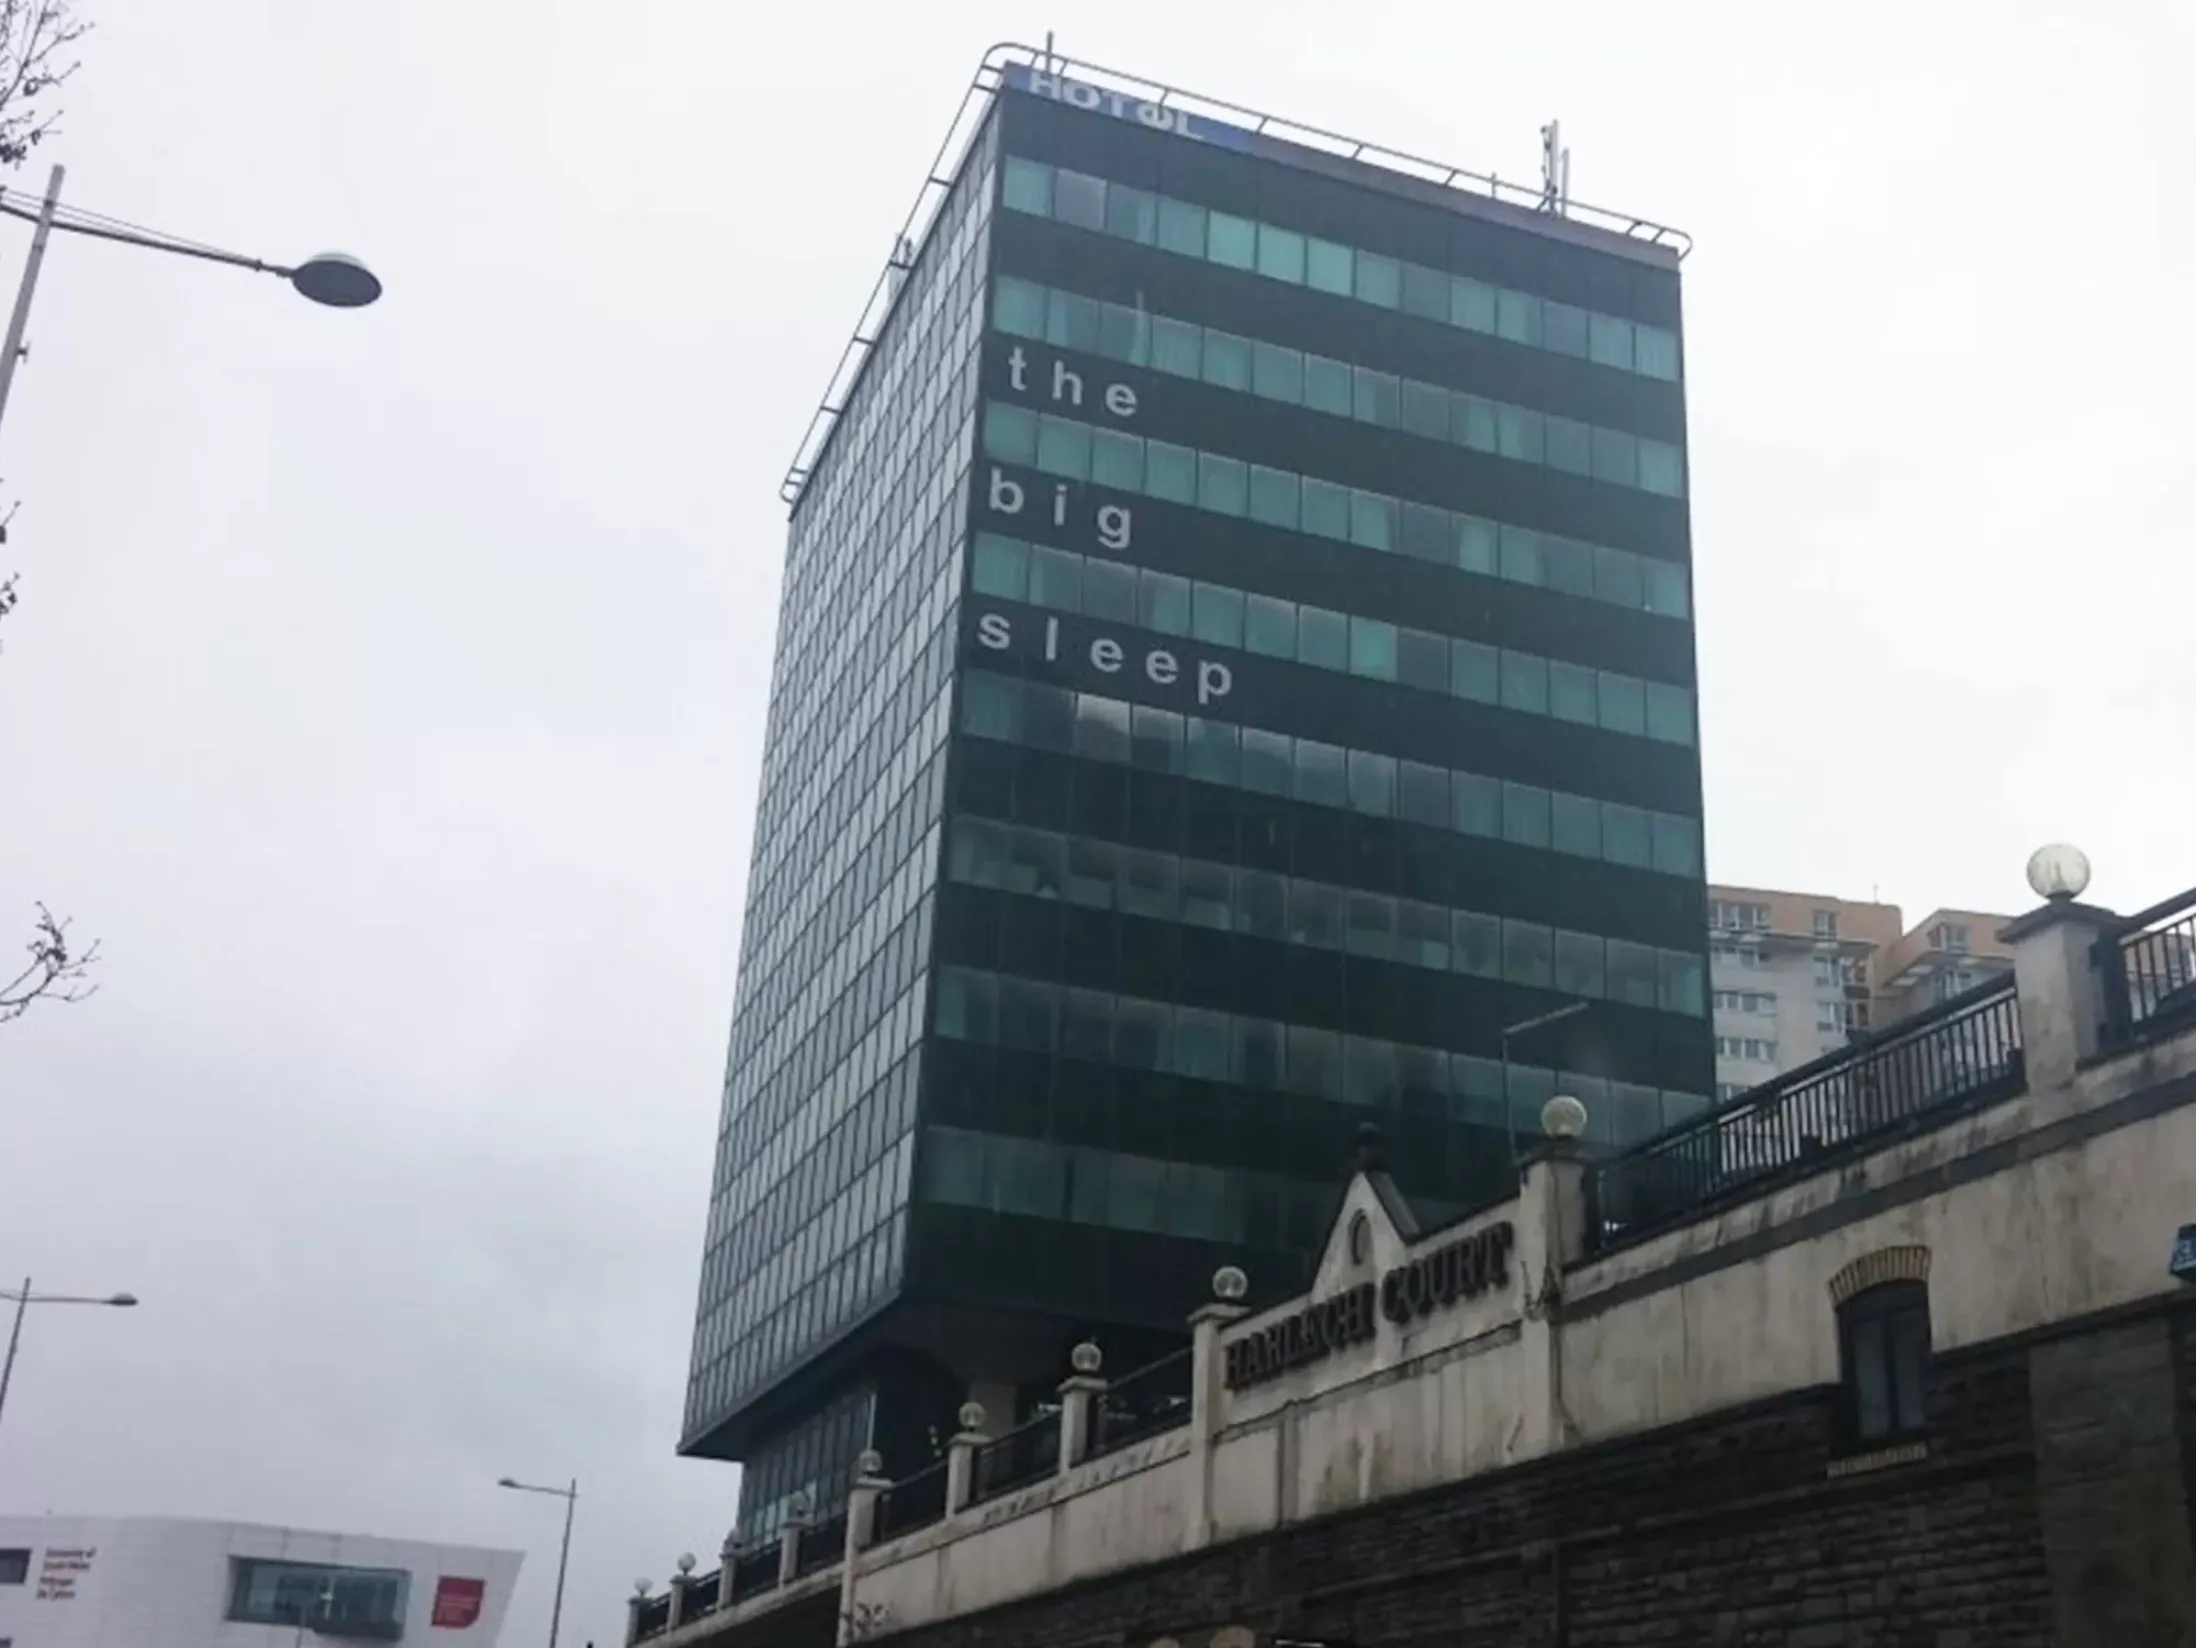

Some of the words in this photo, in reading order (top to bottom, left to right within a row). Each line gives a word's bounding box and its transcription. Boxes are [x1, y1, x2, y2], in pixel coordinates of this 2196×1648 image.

[1009, 347, 1137, 417] the
[989, 467, 1133, 549] big
[979, 612, 1232, 704] sleep
[1382, 1221, 1513, 1325] COURT
